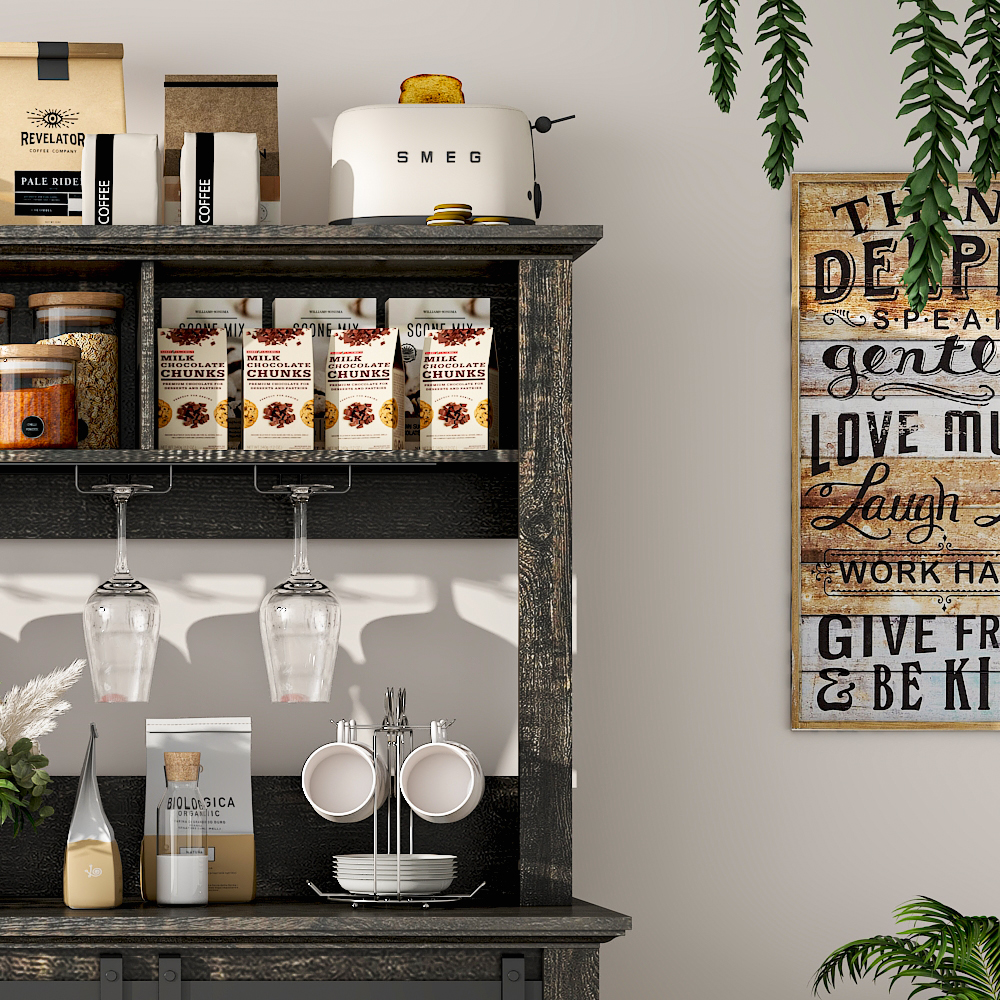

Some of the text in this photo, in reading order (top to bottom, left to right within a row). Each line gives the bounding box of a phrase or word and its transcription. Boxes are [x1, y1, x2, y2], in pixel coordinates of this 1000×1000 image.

[21, 131, 85, 147] REVELATOR
[397, 151, 481, 163] SMEG
[21, 177, 82, 186] PALE RIDE
[98, 180, 110, 225] COFFEE
[198, 179, 211, 224] COFFEE
[161, 369, 225, 378] CHUNKS
[247, 369, 311, 378] CHUNKS
[327, 369, 390, 379] CHUNKS
[422, 369, 486, 379] CHUNKS
[811, 410, 919, 477] LOVE
[804, 462, 960, 544] Laugh
[839, 560, 941, 584] WORK
[818, 613, 937, 660] GIVE
[816, 667, 856, 712] &
[872, 660, 923, 711] BE
[167, 796, 235, 810] BIOLOGICA
